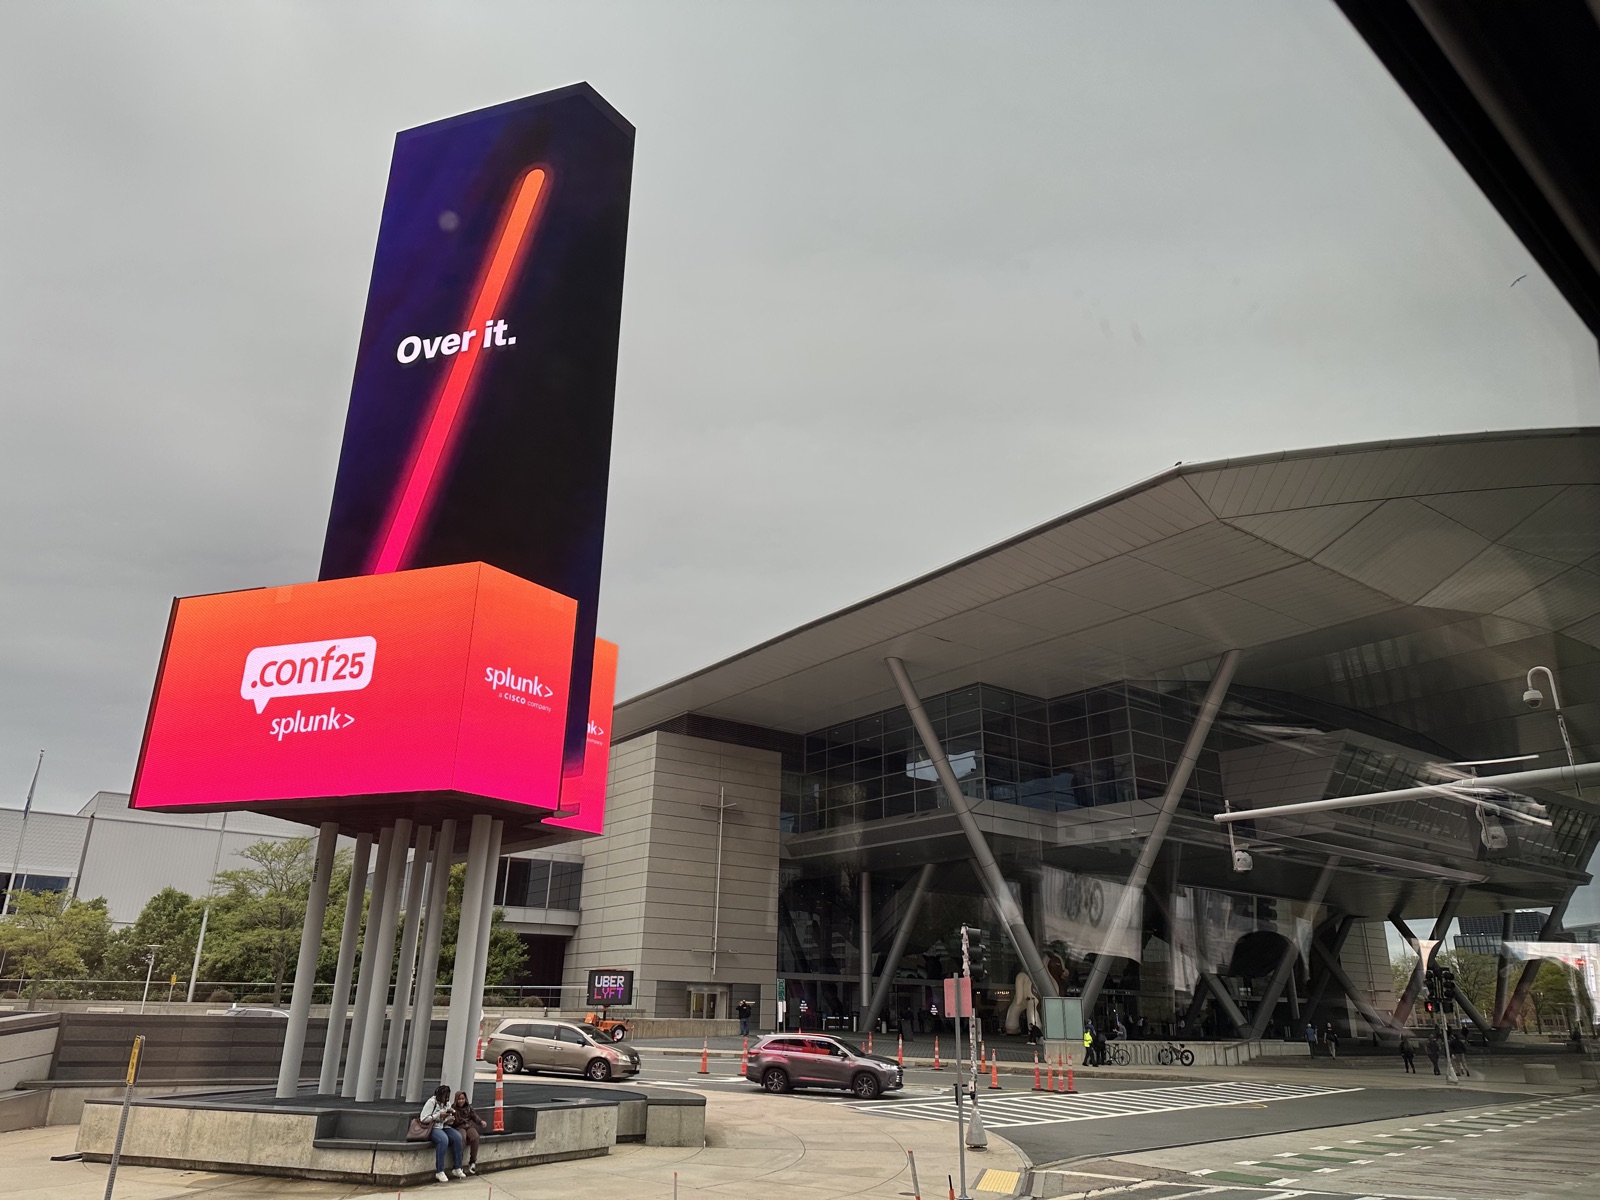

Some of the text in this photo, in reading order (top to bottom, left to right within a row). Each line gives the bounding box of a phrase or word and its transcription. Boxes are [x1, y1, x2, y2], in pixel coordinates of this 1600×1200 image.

[396, 319, 517, 364] Over it.
[251, 645, 365, 688] .conf25
[527, 701, 551, 713] company
[594, 975, 625, 988] UBER
[593, 987, 625, 1000] LYFT
